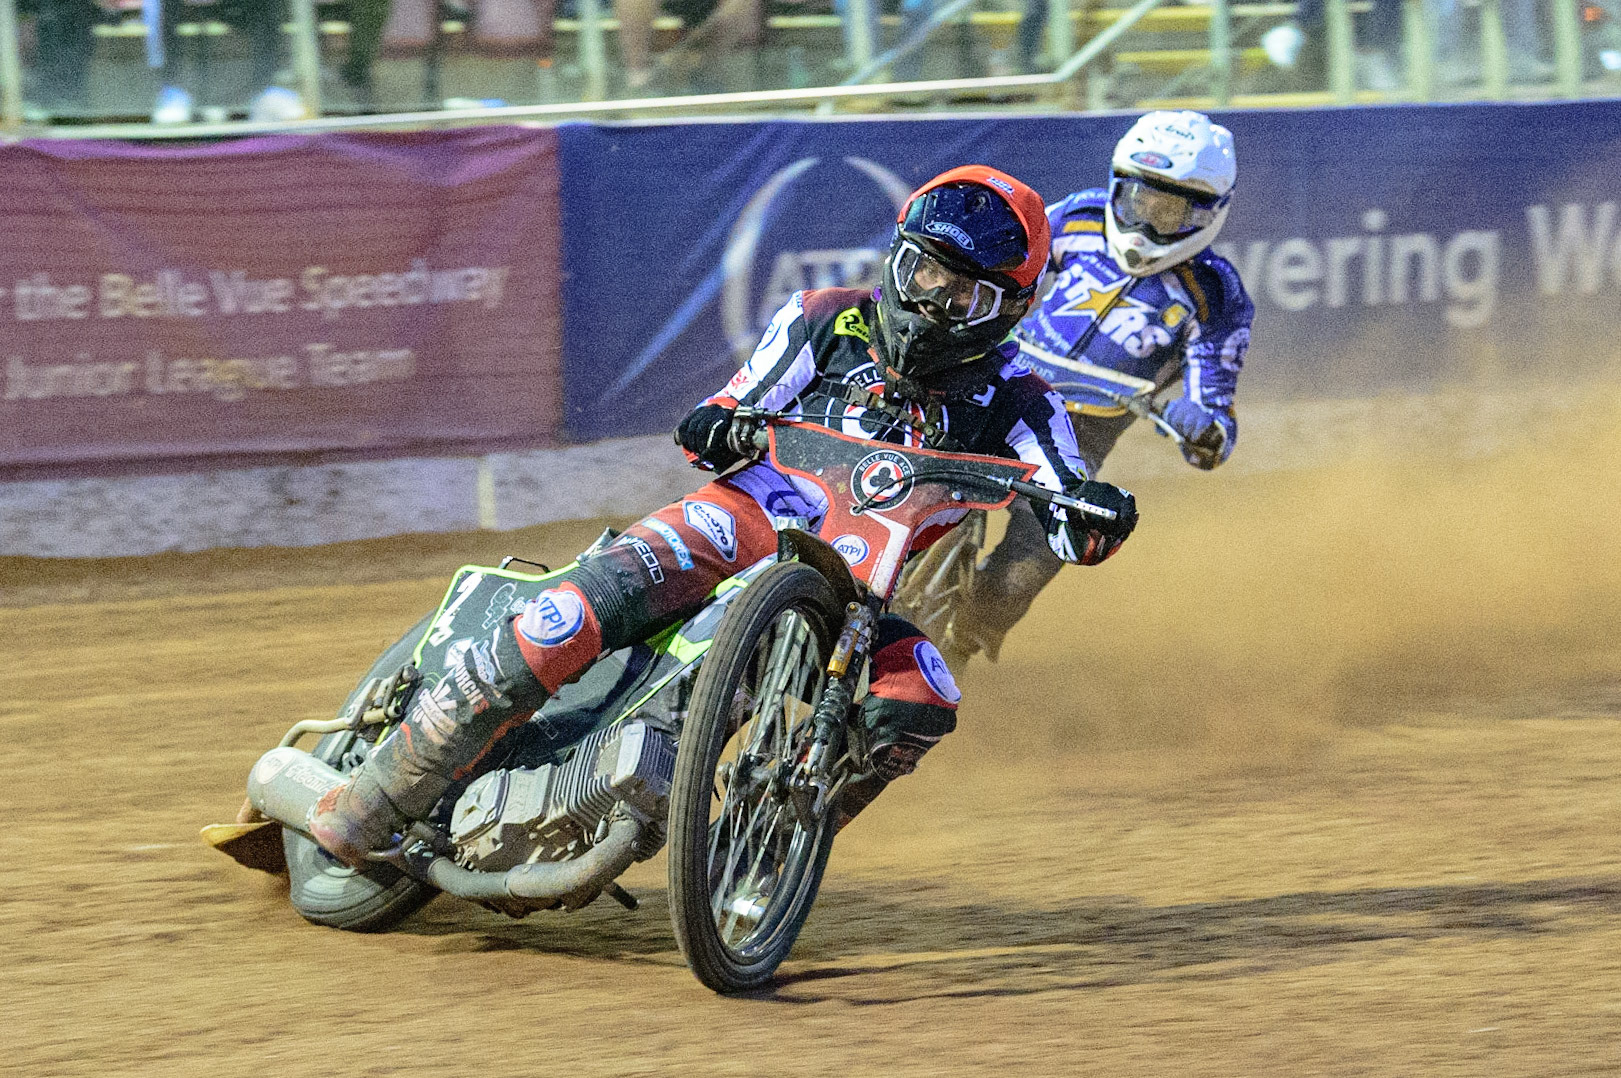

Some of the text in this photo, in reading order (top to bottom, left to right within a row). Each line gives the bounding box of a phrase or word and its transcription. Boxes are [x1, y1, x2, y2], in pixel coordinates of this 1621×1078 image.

[931, 223, 970, 247] SHOEI
[1211, 201, 1621, 329] ering W
[14, 258, 510, 321] the Belle Vue Speedway
[5, 343, 416, 403] Junior League Team
[852, 369, 882, 388] ELL
[859, 453, 911, 477] BELLE VUE ACE
[837, 544, 862, 557] ATPI
